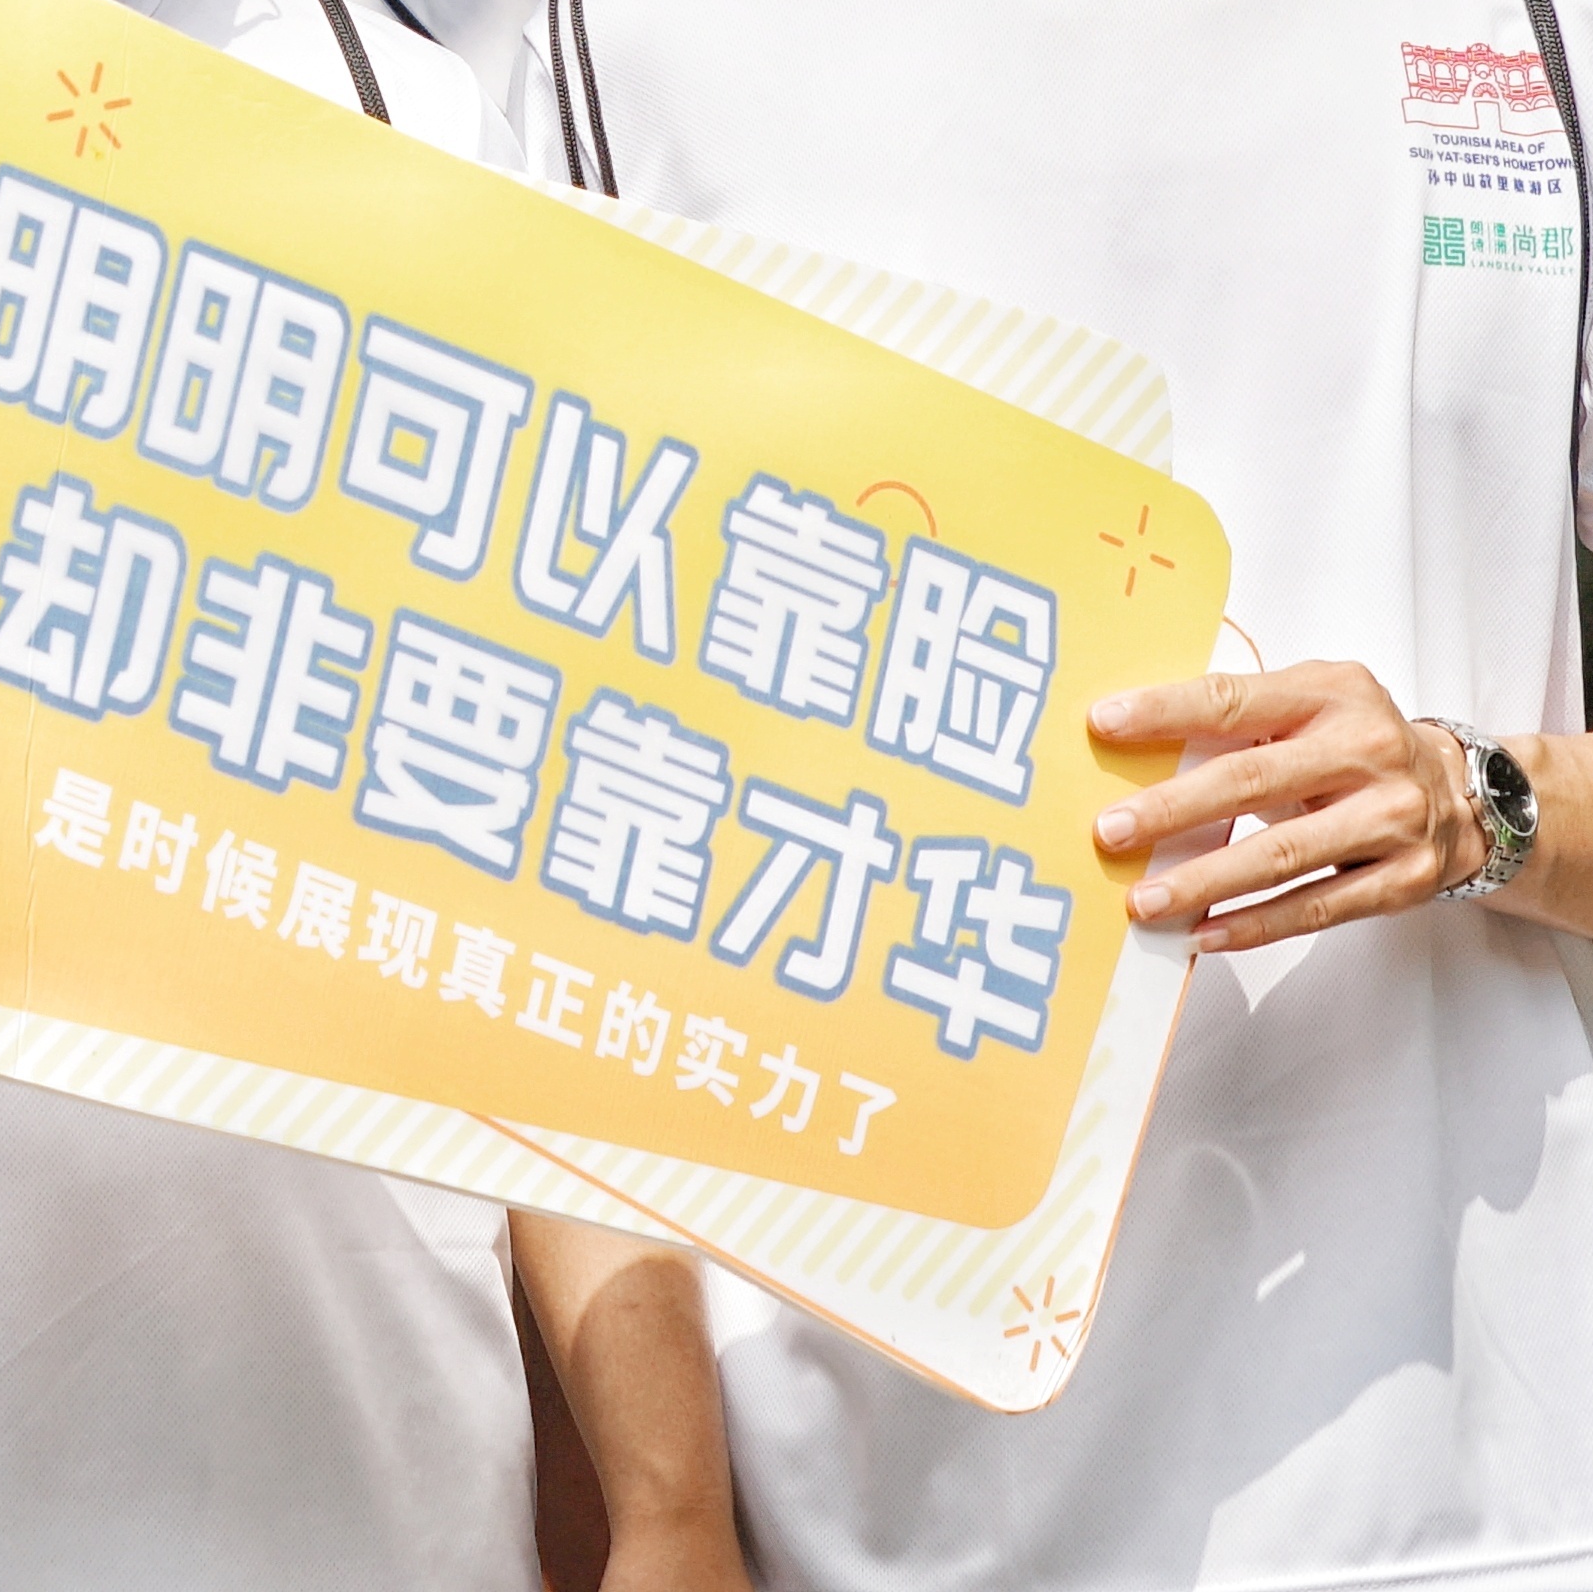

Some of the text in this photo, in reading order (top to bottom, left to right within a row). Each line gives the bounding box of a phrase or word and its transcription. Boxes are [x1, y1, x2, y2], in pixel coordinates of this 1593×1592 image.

[1433, 133, 1545, 155] TOURISM AREA OF
[1409, 147, 1434, 160] SUN
[1437, 151, 1500, 167] YAT-SEN'S
[34, 766, 898, 1157] 是时候展现真正的实力了
